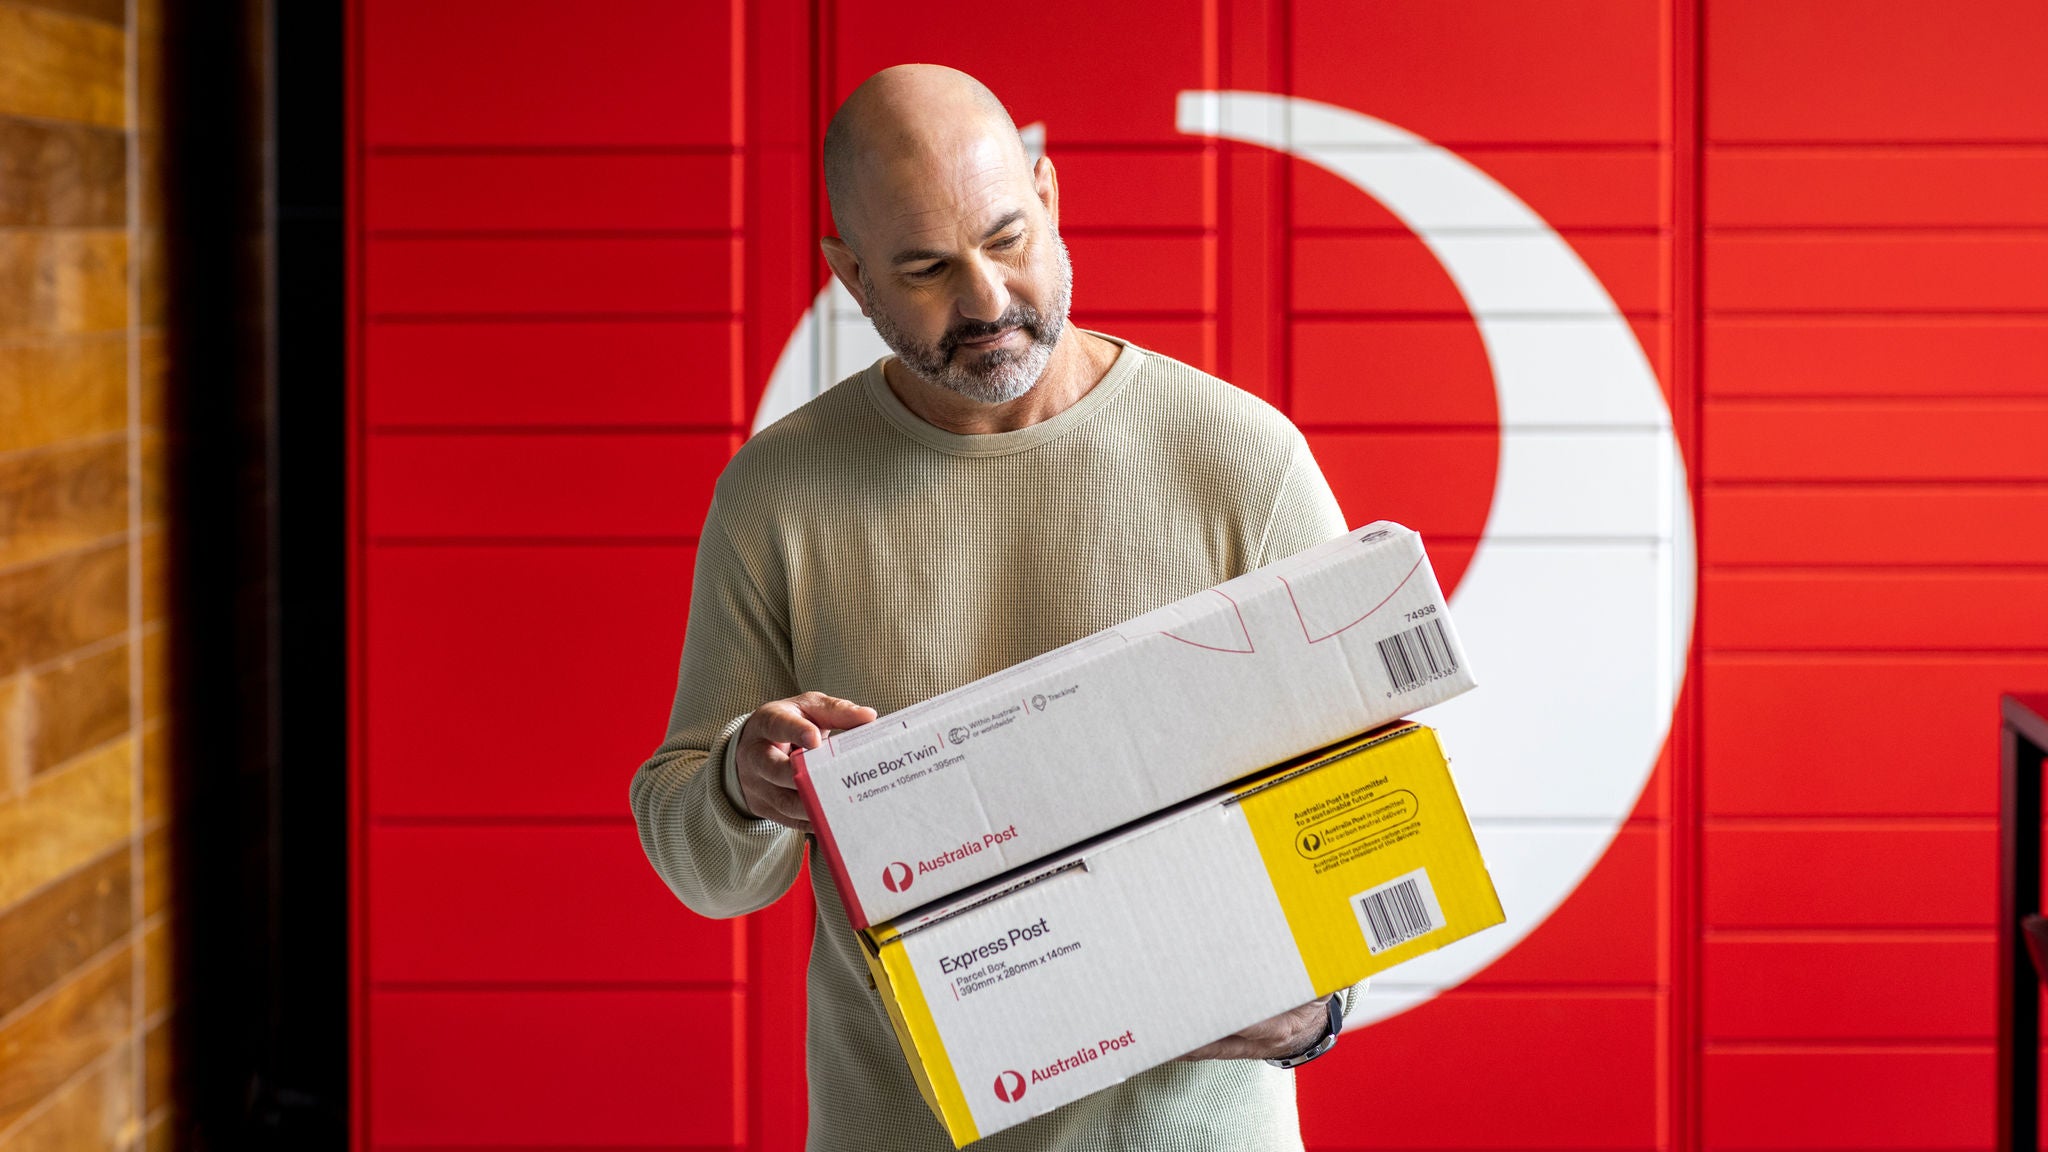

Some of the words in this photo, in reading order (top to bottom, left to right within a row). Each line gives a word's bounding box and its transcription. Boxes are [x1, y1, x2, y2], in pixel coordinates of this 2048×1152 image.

[1404, 604, 1437, 623] 74938
[1386, 691, 1392, 699] 9
[969, 718, 990, 729] Within
[992, 706, 1021, 720] Australia
[841, 767, 878, 789] Wine
[878, 757, 905, 775] Box
[904, 745, 938, 764] Twin
[857, 784, 890, 802] 240mm
[890, 782, 897, 790] x
[896, 770, 927, 786] 105mm
[928, 766, 934, 774] x
[933, 754, 965, 772] 395mm
[1294, 802, 1326, 820] Australia
[1326, 794, 1342, 807] Post
[1342, 792, 1350, 801] is
[1350, 776, 1388, 797] committed
[1296, 819, 1305, 827] to
[1311, 801, 1351, 820] sustainable
[1351, 792, 1374, 805] future
[1325, 821, 1352, 836] Australia
[1351, 814, 1367, 825] Post
[1373, 798, 1405, 816] committed
[1335, 827, 1357, 841] carbon
[1358, 818, 1381, 832] neutral
[1381, 807, 1407, 822] delivery
[918, 841, 983, 875] Australia
[982, 824, 1018, 848] Post
[939, 937, 1008, 974] Express
[1007, 917, 1050, 947] Post
[956, 967, 987, 986] Parcel
[988, 961, 1006, 974] Box
[959, 977, 996, 997] 390mm
[997, 973, 1003, 982] x
[1003, 960, 1039, 980] 280mm
[1039, 956, 1047, 964] x
[1046, 941, 1082, 961] 140mm
[1031, 1047, 1098, 1085] Australia
[1098, 1030, 1136, 1055] Post
